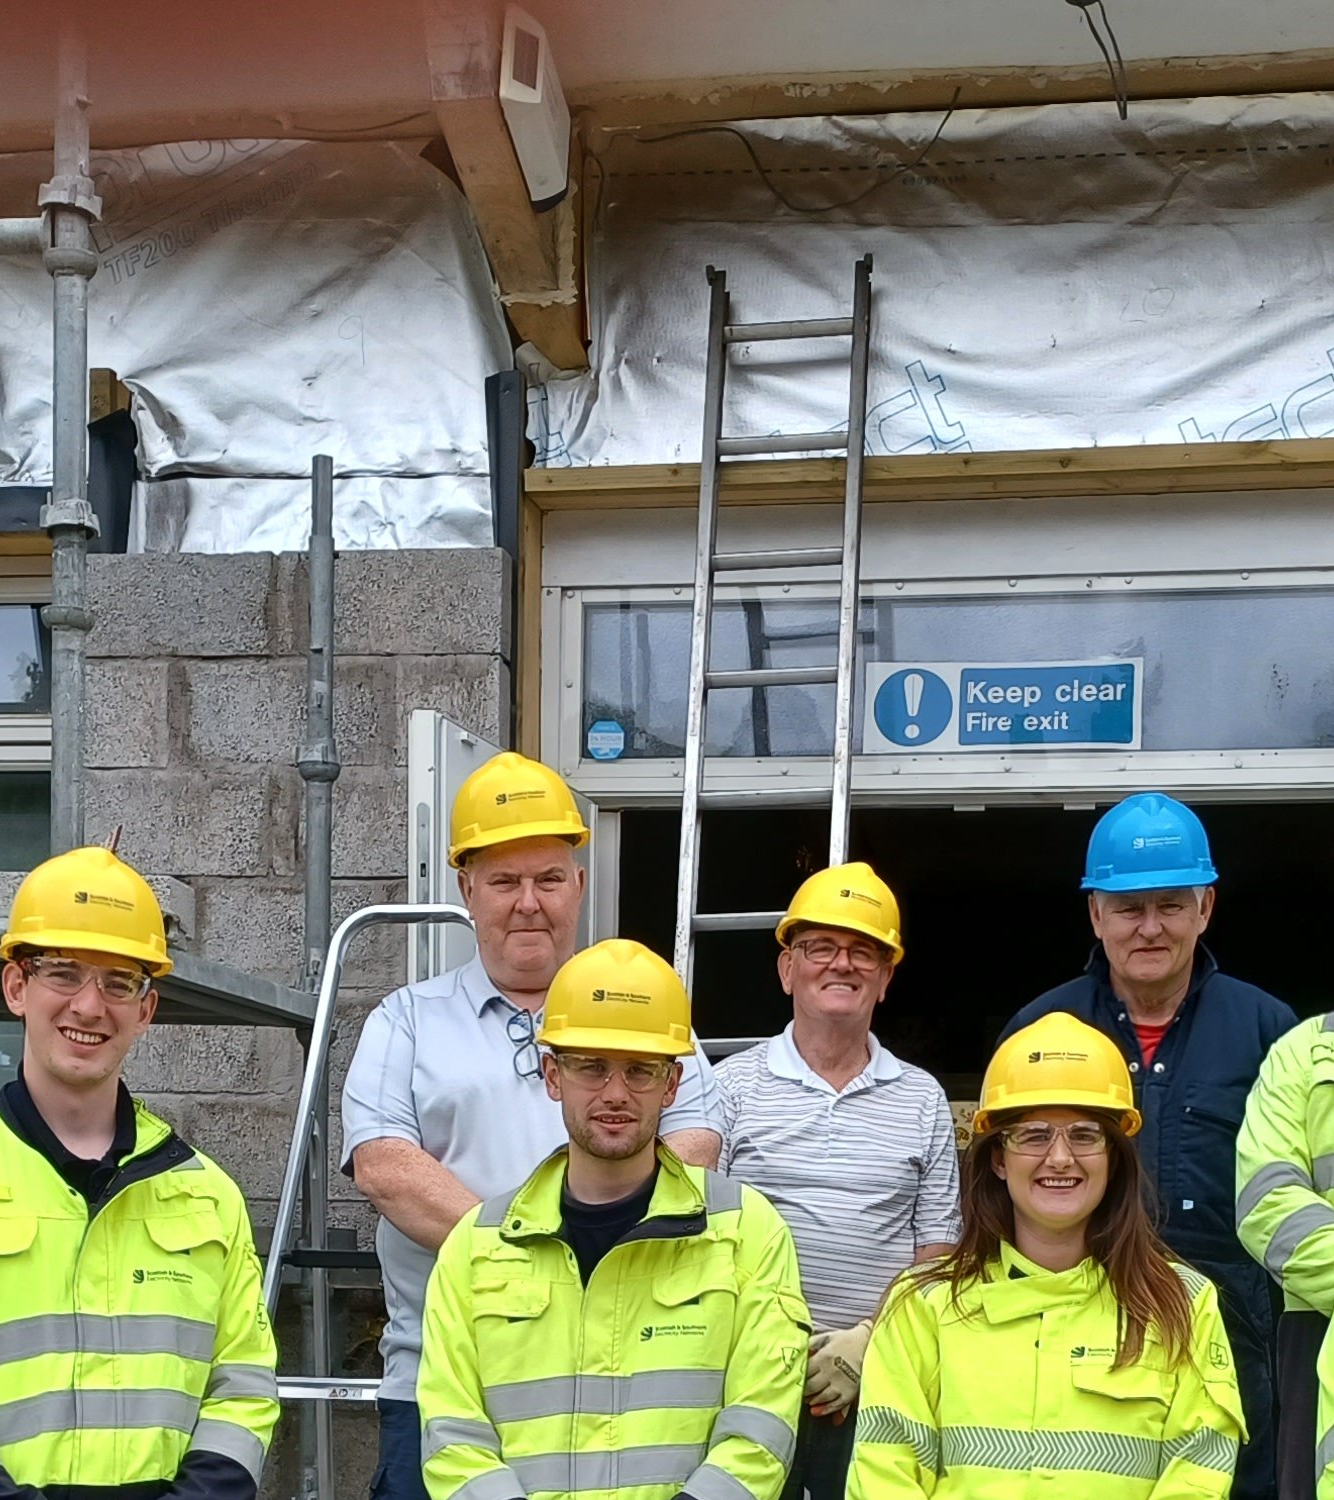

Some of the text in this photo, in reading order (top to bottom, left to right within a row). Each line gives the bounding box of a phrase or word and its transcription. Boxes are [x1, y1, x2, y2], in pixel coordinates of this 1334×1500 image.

[967, 679, 1127, 707] Keep clear
[967, 711, 1069, 732] Fire exit
